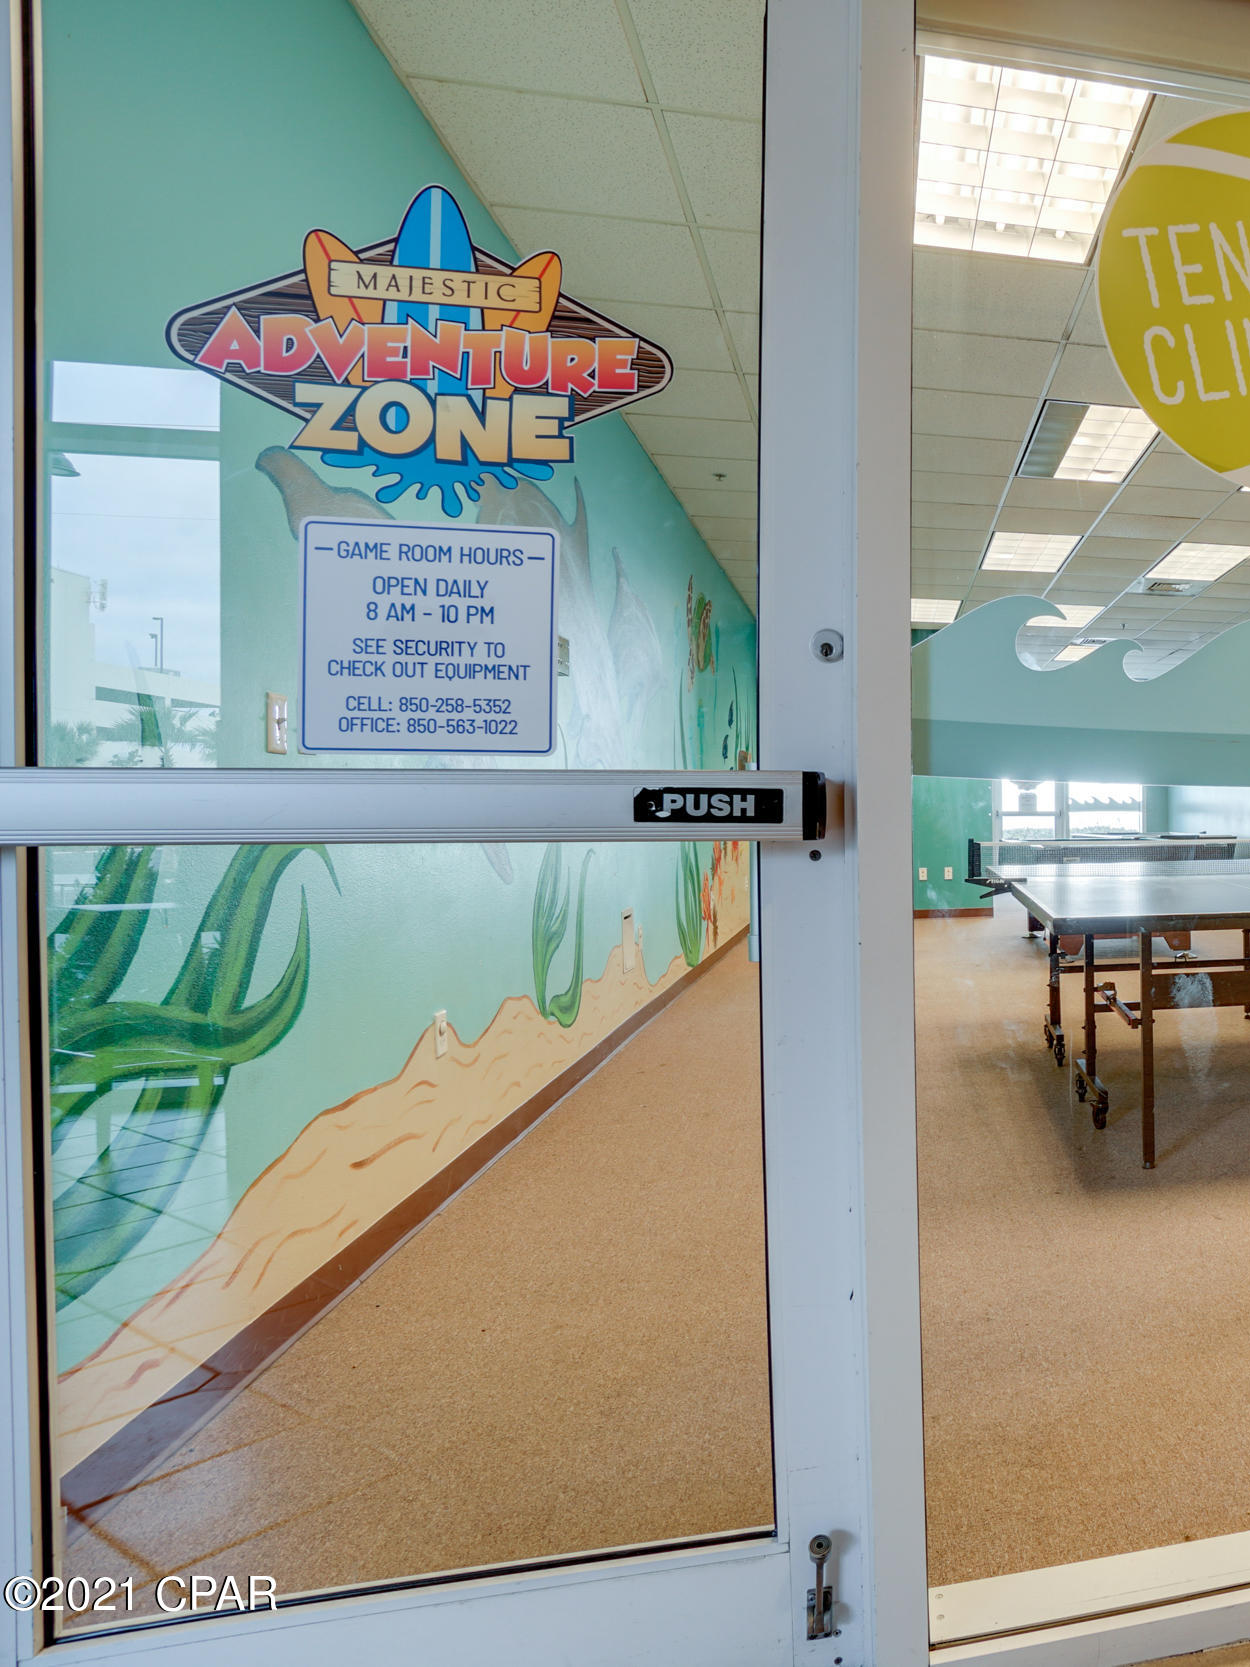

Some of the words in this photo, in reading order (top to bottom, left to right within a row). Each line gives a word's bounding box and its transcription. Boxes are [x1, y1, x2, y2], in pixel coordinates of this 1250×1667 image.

[355, 270, 517, 304] MAJESTIC
[193, 302, 640, 398] ADVENTURE
[286, 378, 575, 464] ZONE
[337, 541, 391, 560] GAME
[398, 543, 452, 563] ROOM
[460, 546, 524, 566] HOURS
[372, 576, 428, 596] OPEN
[435, 579, 489, 598] DAILY
[366, 602, 378, 620] 8
[385, 603, 415, 621] AM
[439, 604, 459, 623] 10
[466, 606, 495, 624] PM
[352, 638, 387, 655] SEE
[393, 639, 478, 657] SECURITY
[484, 642, 506, 658] TO
[327, 660, 386, 678] CHECK
[392, 661, 428, 679] OUT
[434, 662, 531, 681] EQUIPMENT
[345, 696, 393, 712] CELL:
[398, 697, 512, 715] 850-258-5352
[338, 716, 401, 733] OFFICE:
[406, 718, 518, 735] 850-563-1022
[663, 793, 755, 817] PUSH
